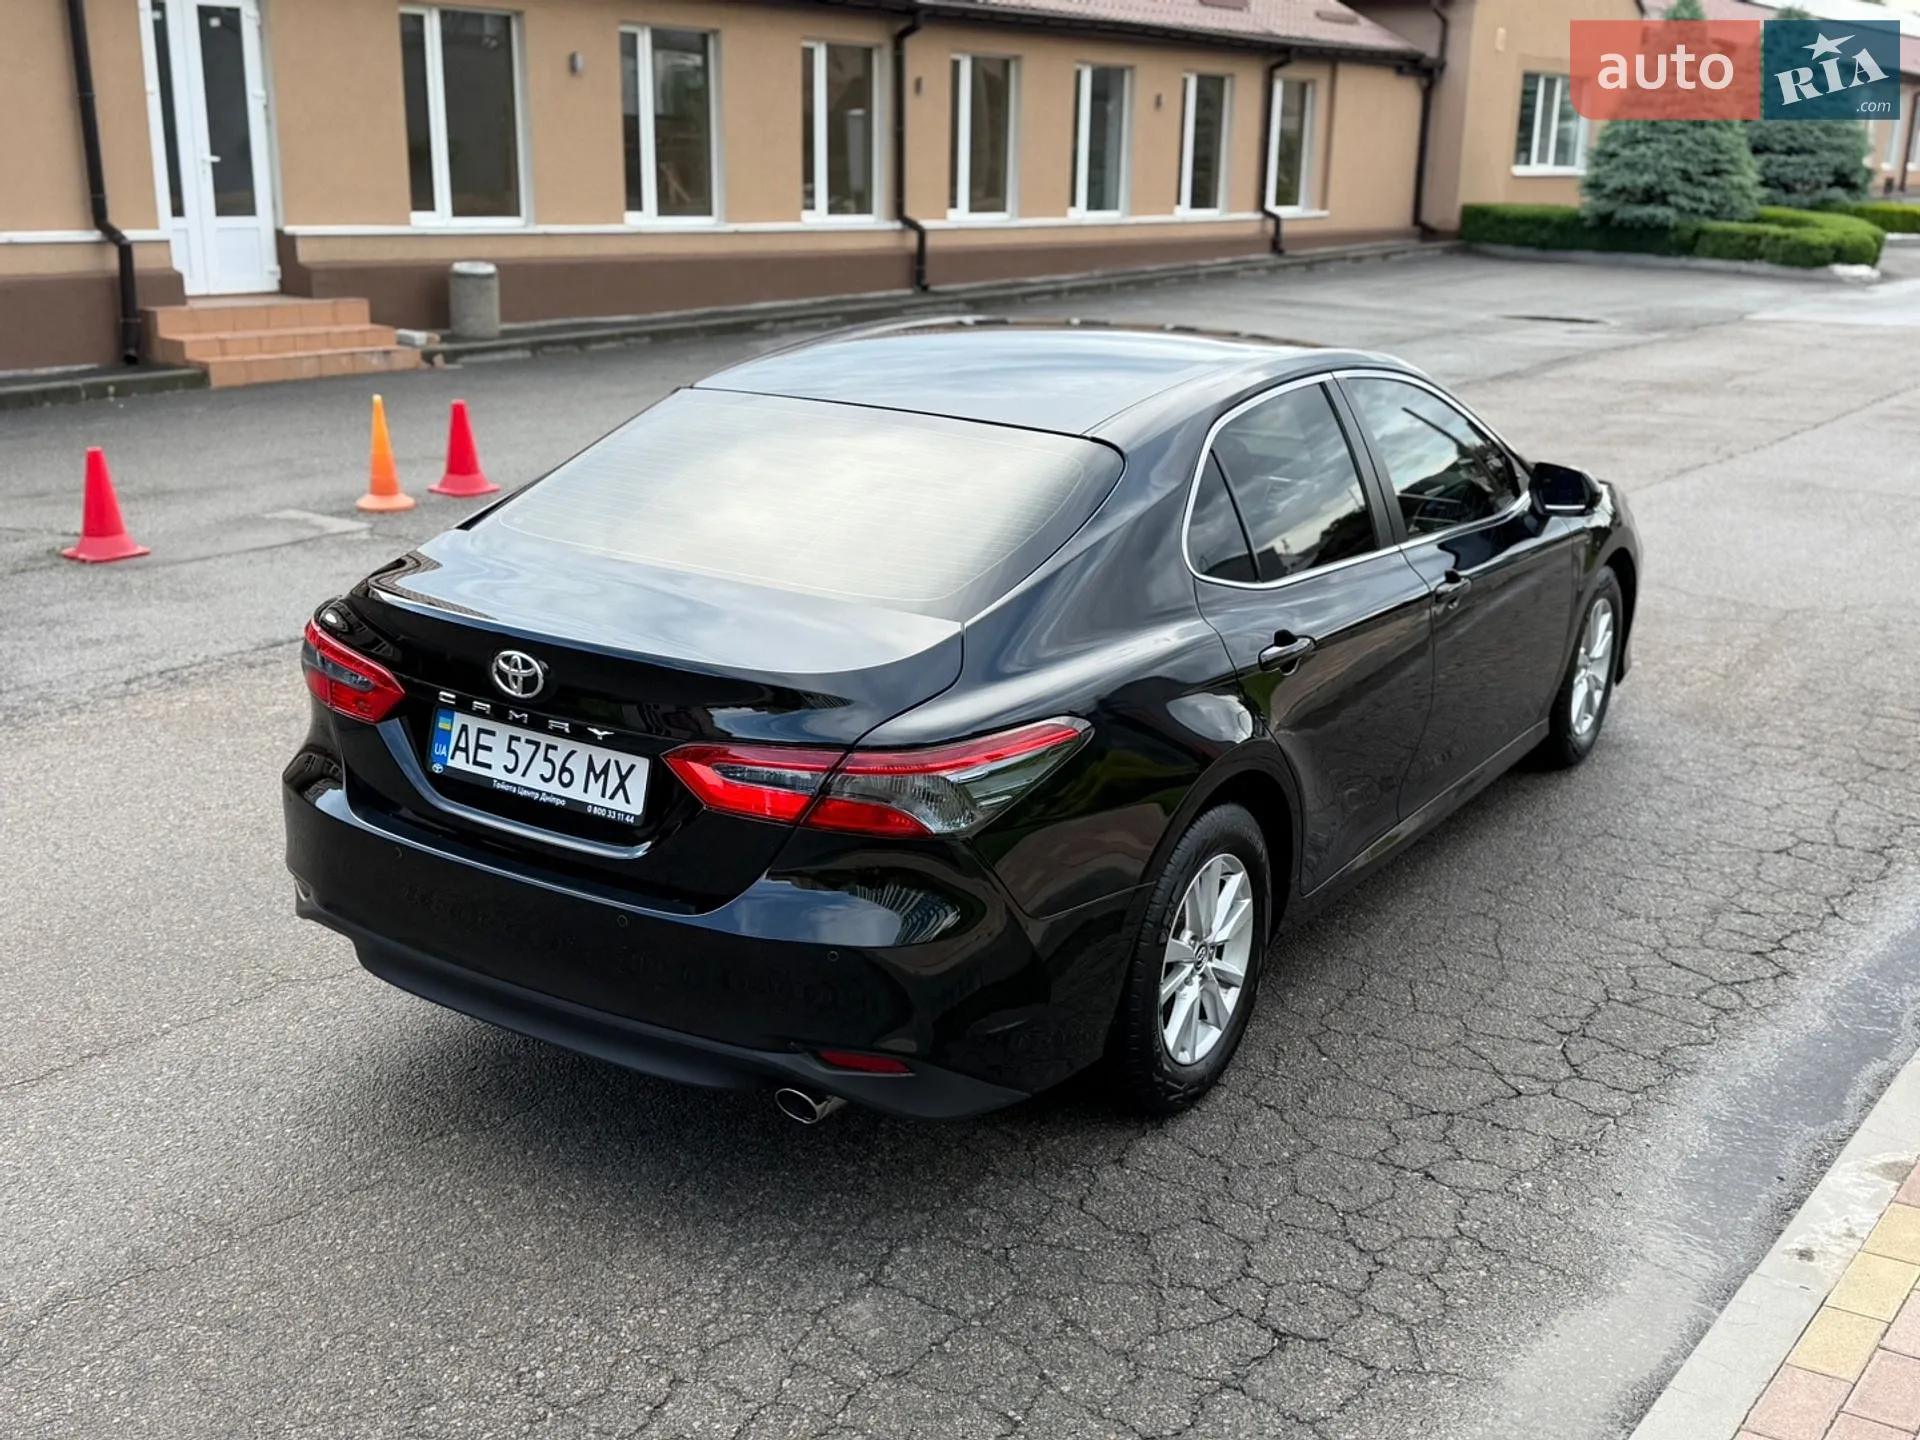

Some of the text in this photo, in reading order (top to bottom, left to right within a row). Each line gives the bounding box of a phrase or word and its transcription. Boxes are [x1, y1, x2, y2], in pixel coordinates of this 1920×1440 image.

[438, 691, 615, 740] CAMRY
[434, 742, 447, 757] UA
[449, 723, 637, 805] AE 5756 MX
[518, 787, 539, 800] Центр
